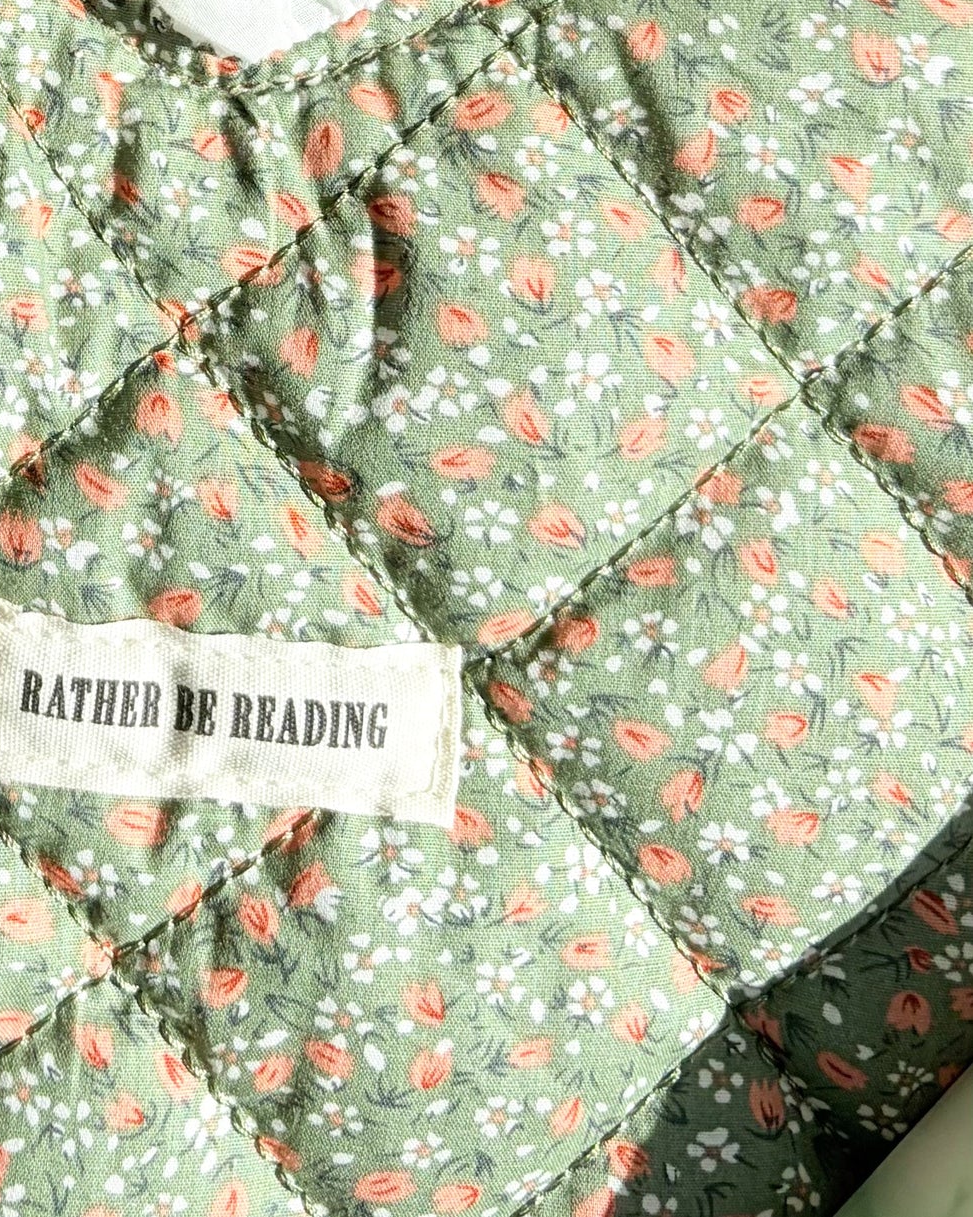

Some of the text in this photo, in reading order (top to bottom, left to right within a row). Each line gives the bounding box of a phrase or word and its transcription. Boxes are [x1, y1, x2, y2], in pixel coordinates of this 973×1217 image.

[20, 669, 388, 749] RATHER BE READING
